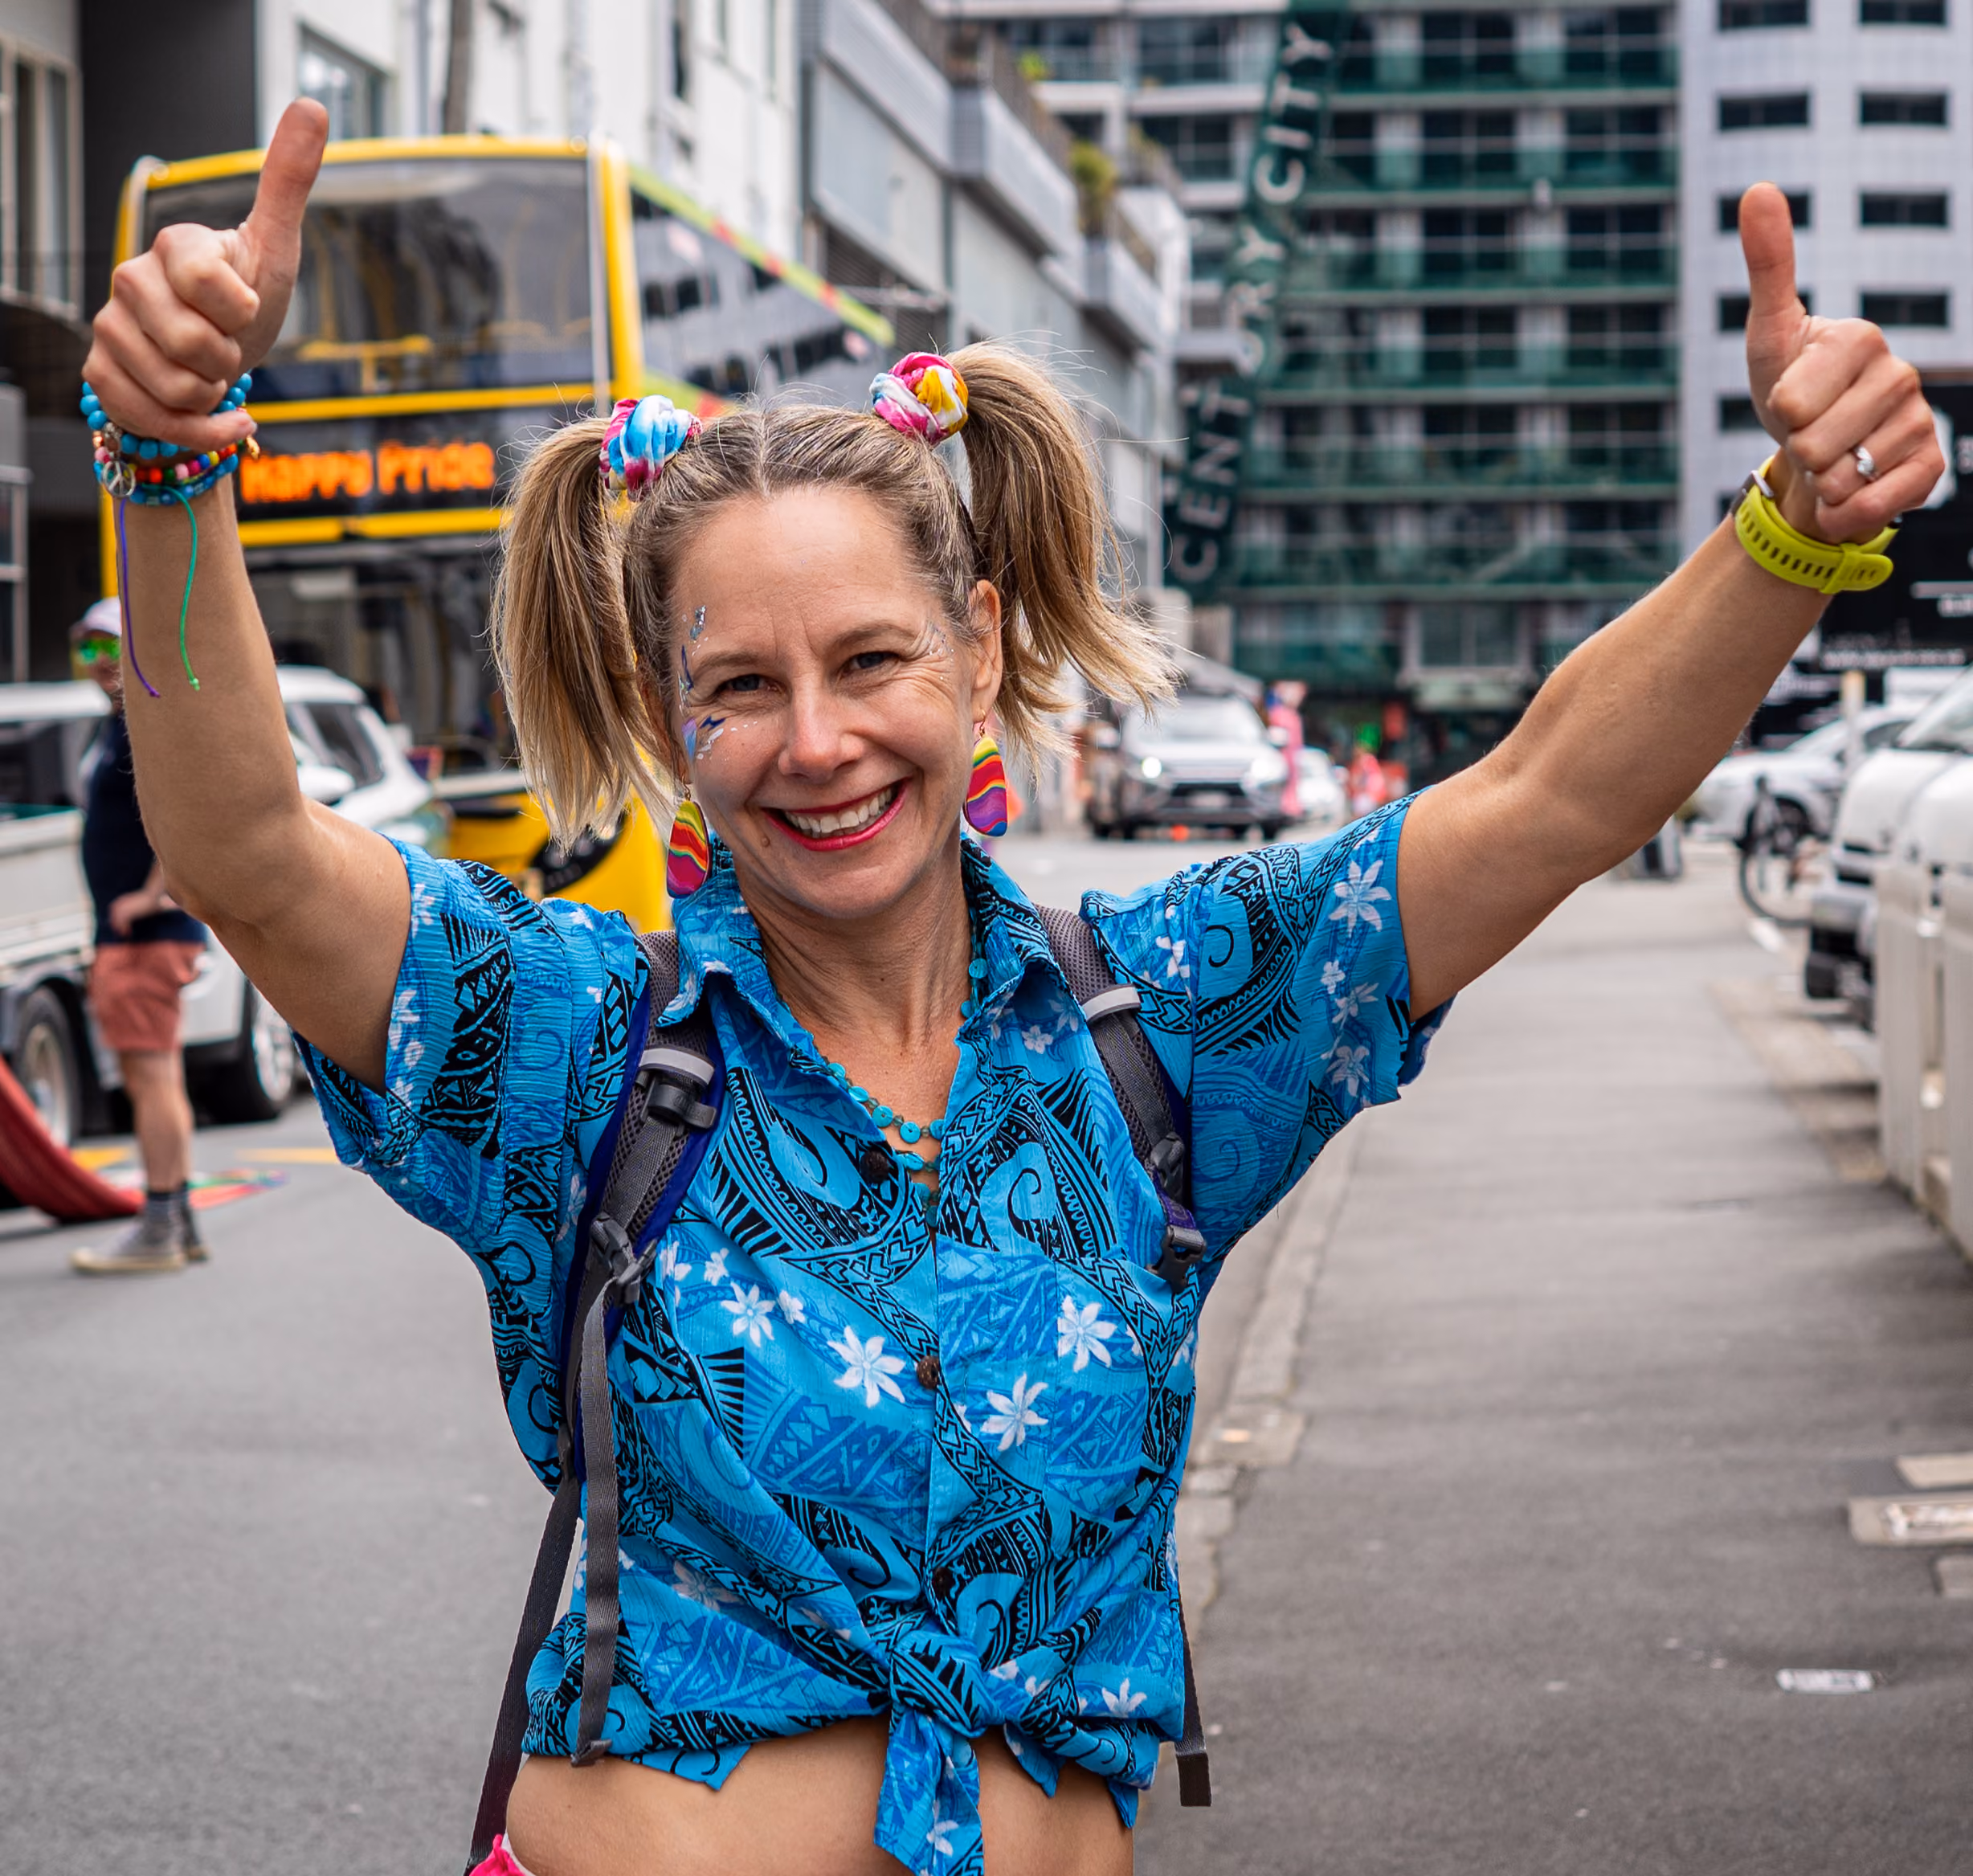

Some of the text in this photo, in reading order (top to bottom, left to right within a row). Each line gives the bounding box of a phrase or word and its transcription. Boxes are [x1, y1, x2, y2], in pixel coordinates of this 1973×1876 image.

[1253, 21, 1332, 204] CITY
[241, 439, 495, 504] Happy Pride
